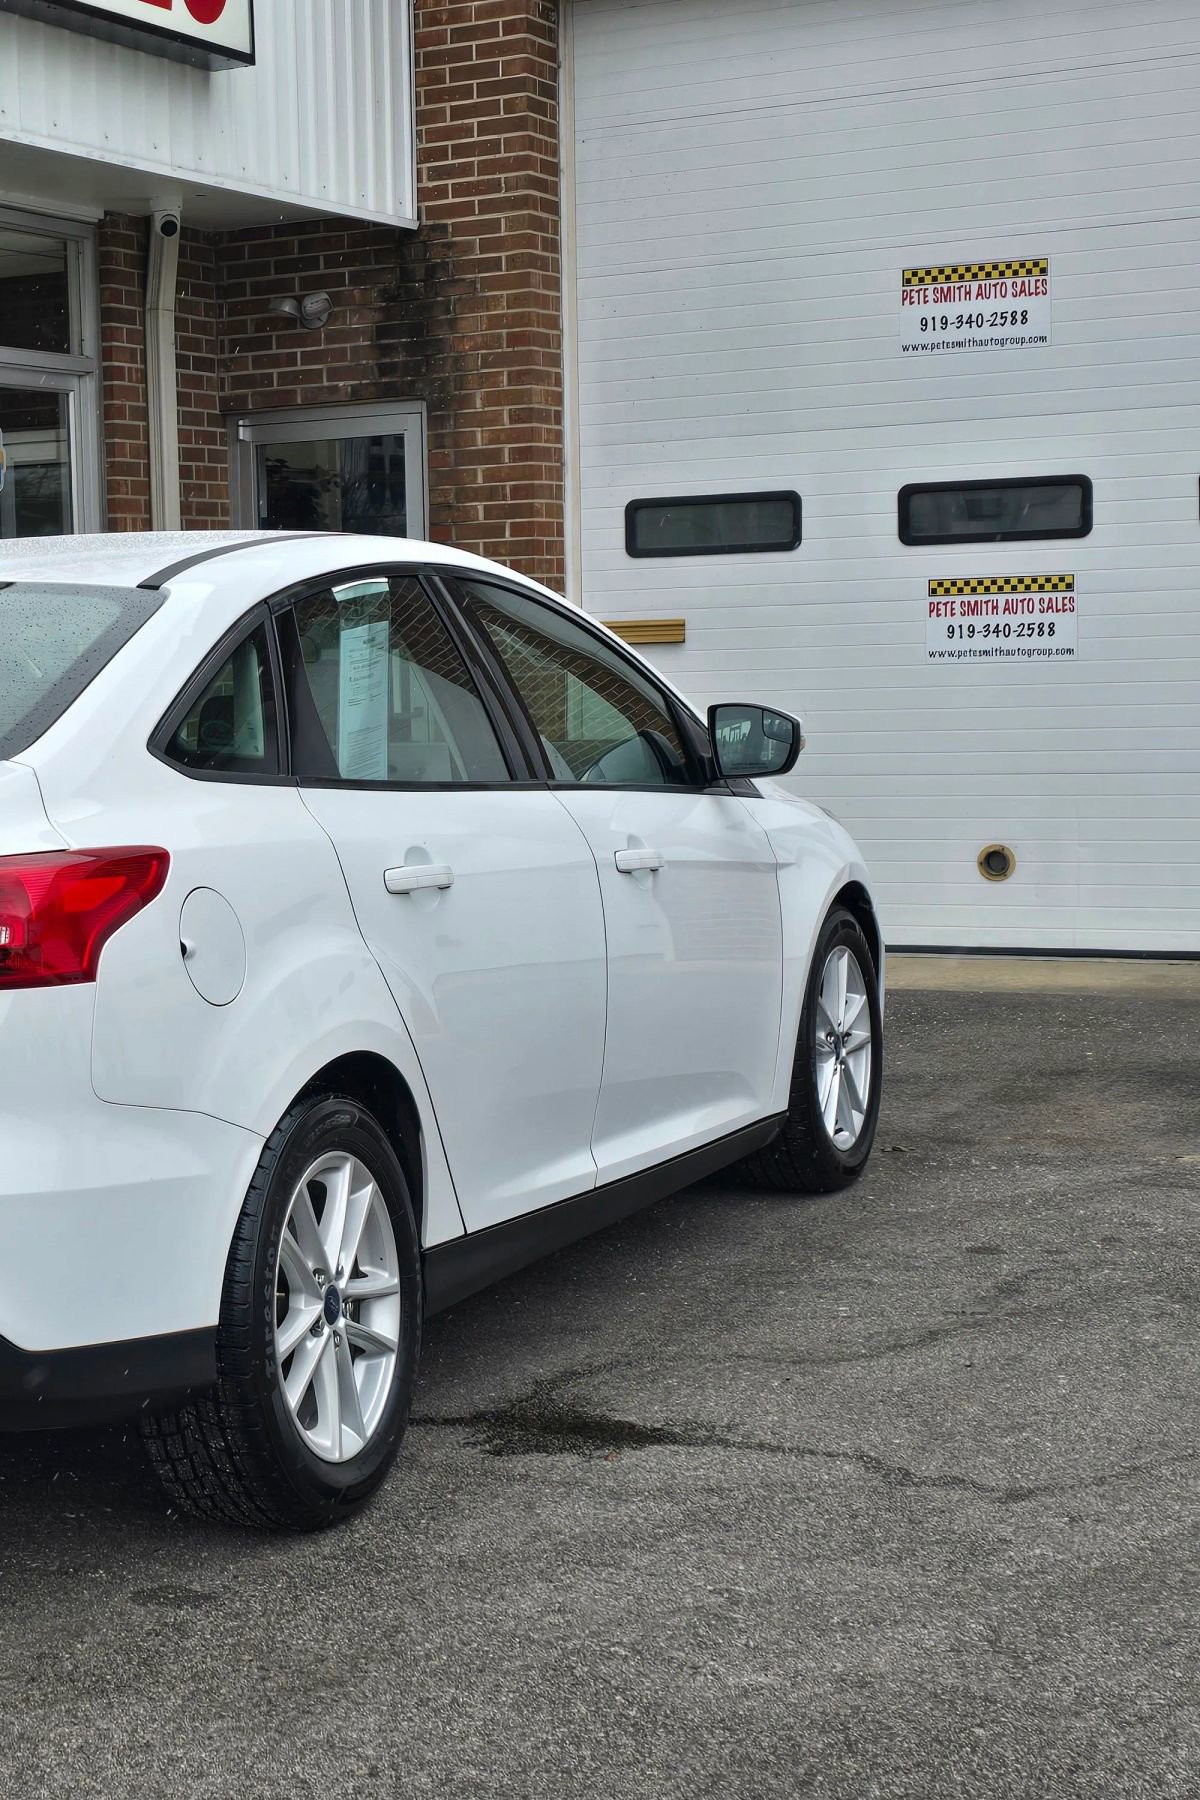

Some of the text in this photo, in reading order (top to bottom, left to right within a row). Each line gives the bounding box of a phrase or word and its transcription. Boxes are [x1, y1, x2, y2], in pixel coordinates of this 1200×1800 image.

[902, 278, 1048, 306] PETE SMITH AUTO SALES
[920, 310, 1028, 332] 919-340-2588
[902, 335, 1048, 352] www.petesmithautogroup.com
[928, 596, 1075, 618] PETE SMITH AUTO SALES
[947, 622, 1056, 640] 919-340-2588
[928, 646, 1075, 659] www.petesmithautogroup.com
